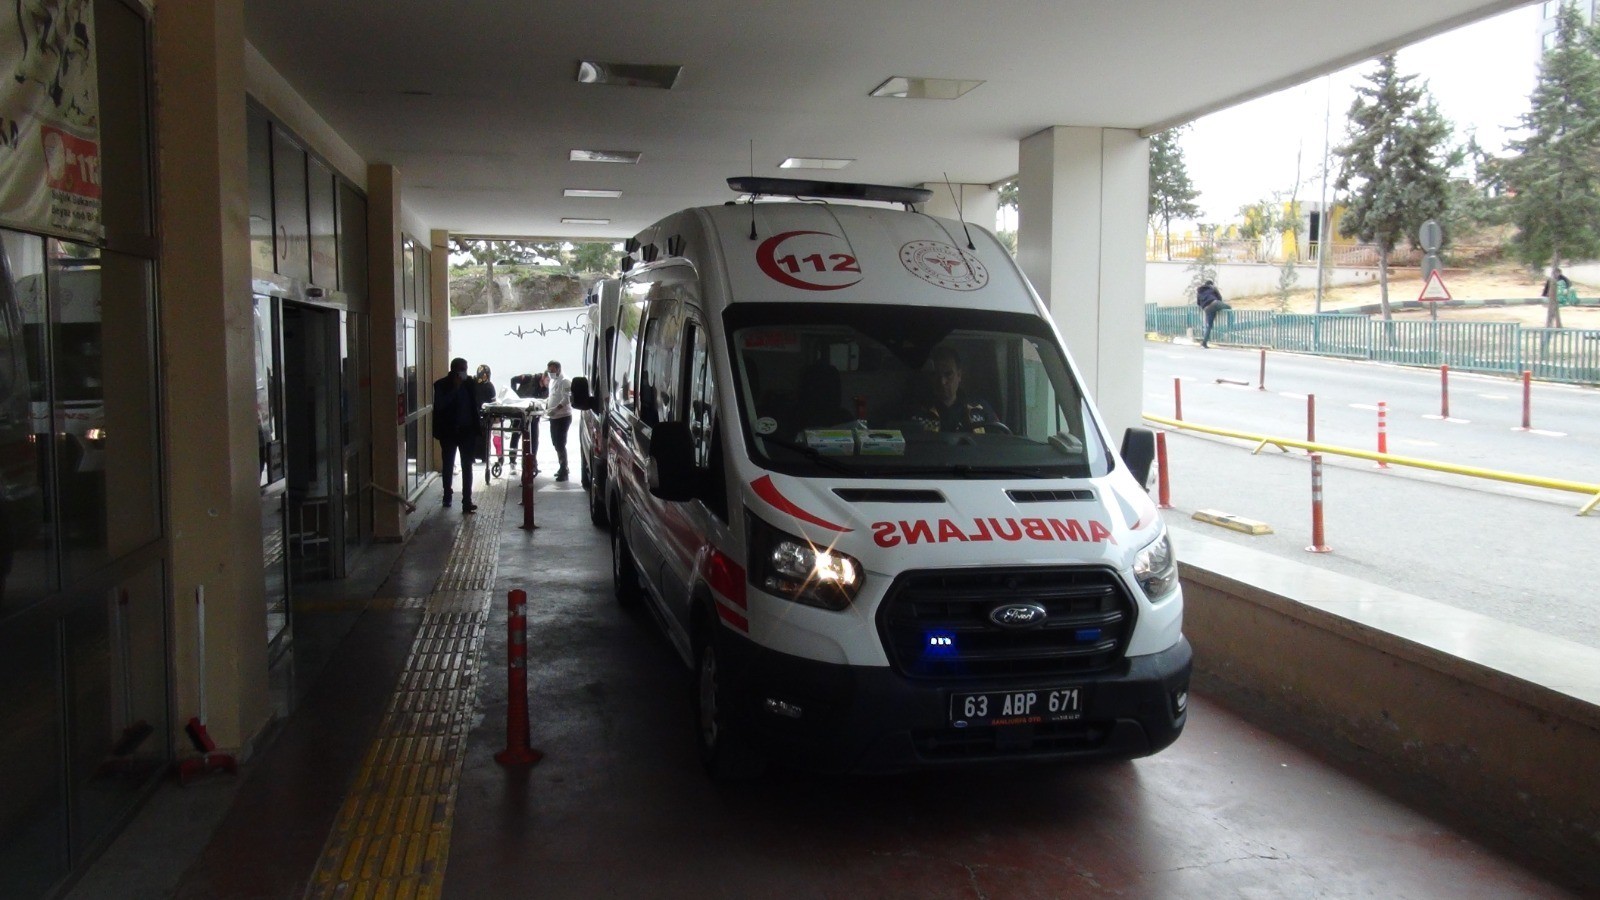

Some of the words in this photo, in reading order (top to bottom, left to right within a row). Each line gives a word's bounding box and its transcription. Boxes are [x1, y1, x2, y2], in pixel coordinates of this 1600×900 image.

[777, 253, 862, 274] 112
[1002, 607, 1036, 623] Ford
[964, 695, 988, 718] 63
[1002, 692, 1037, 716] ABP
[1048, 688, 1079, 712] 671
